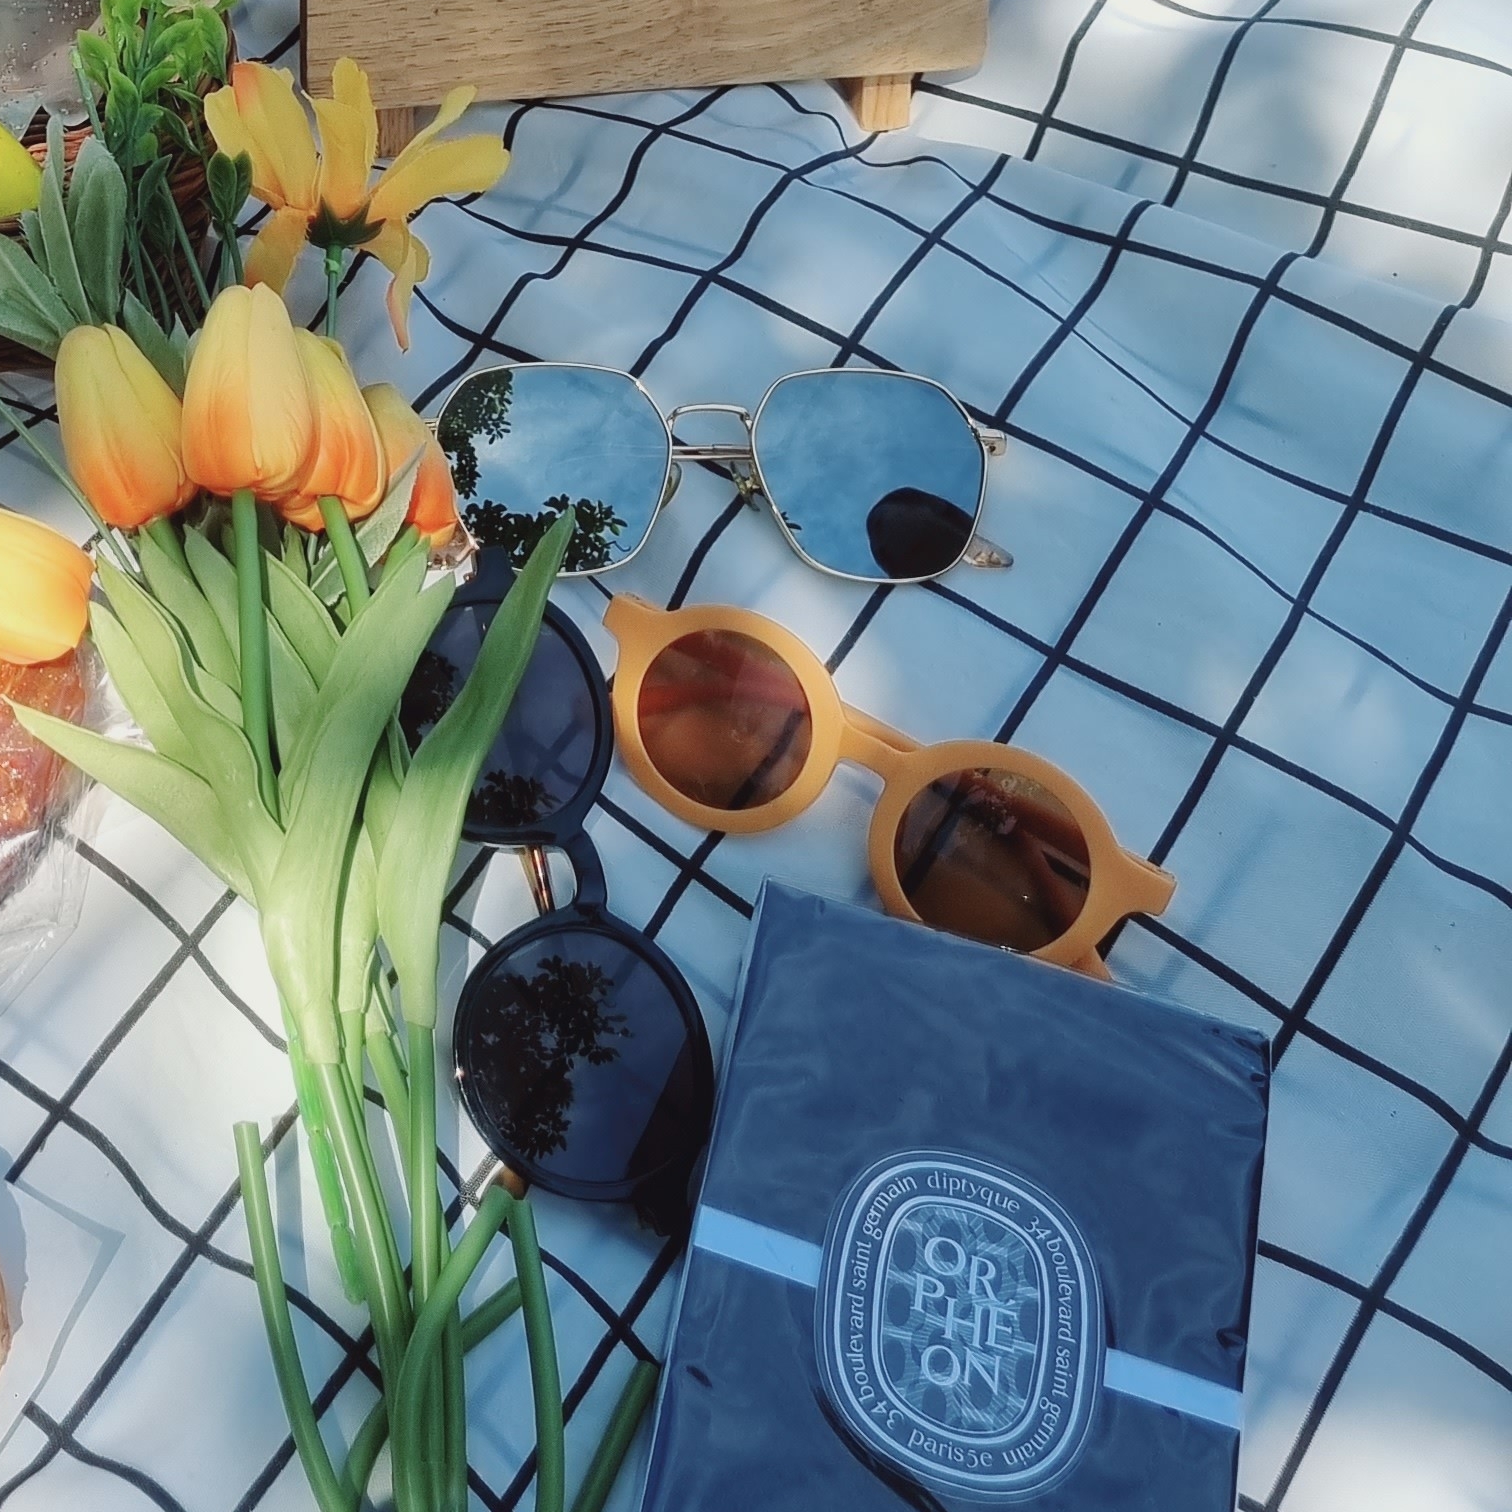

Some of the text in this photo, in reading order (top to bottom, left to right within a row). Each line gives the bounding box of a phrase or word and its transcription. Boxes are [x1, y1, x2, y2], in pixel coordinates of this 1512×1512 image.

[926, 1170, 1021, 1215] diptyque
[845, 1174, 918, 1431] 34 boulevard saint germain
[924, 1236, 1005, 1305] OR
[1046, 1236, 1078, 1345] boulevard
[920, 1344, 1002, 1396] ON
[1055, 1346, 1072, 1398] saint
[1002, 1396, 1062, 1465] germain
